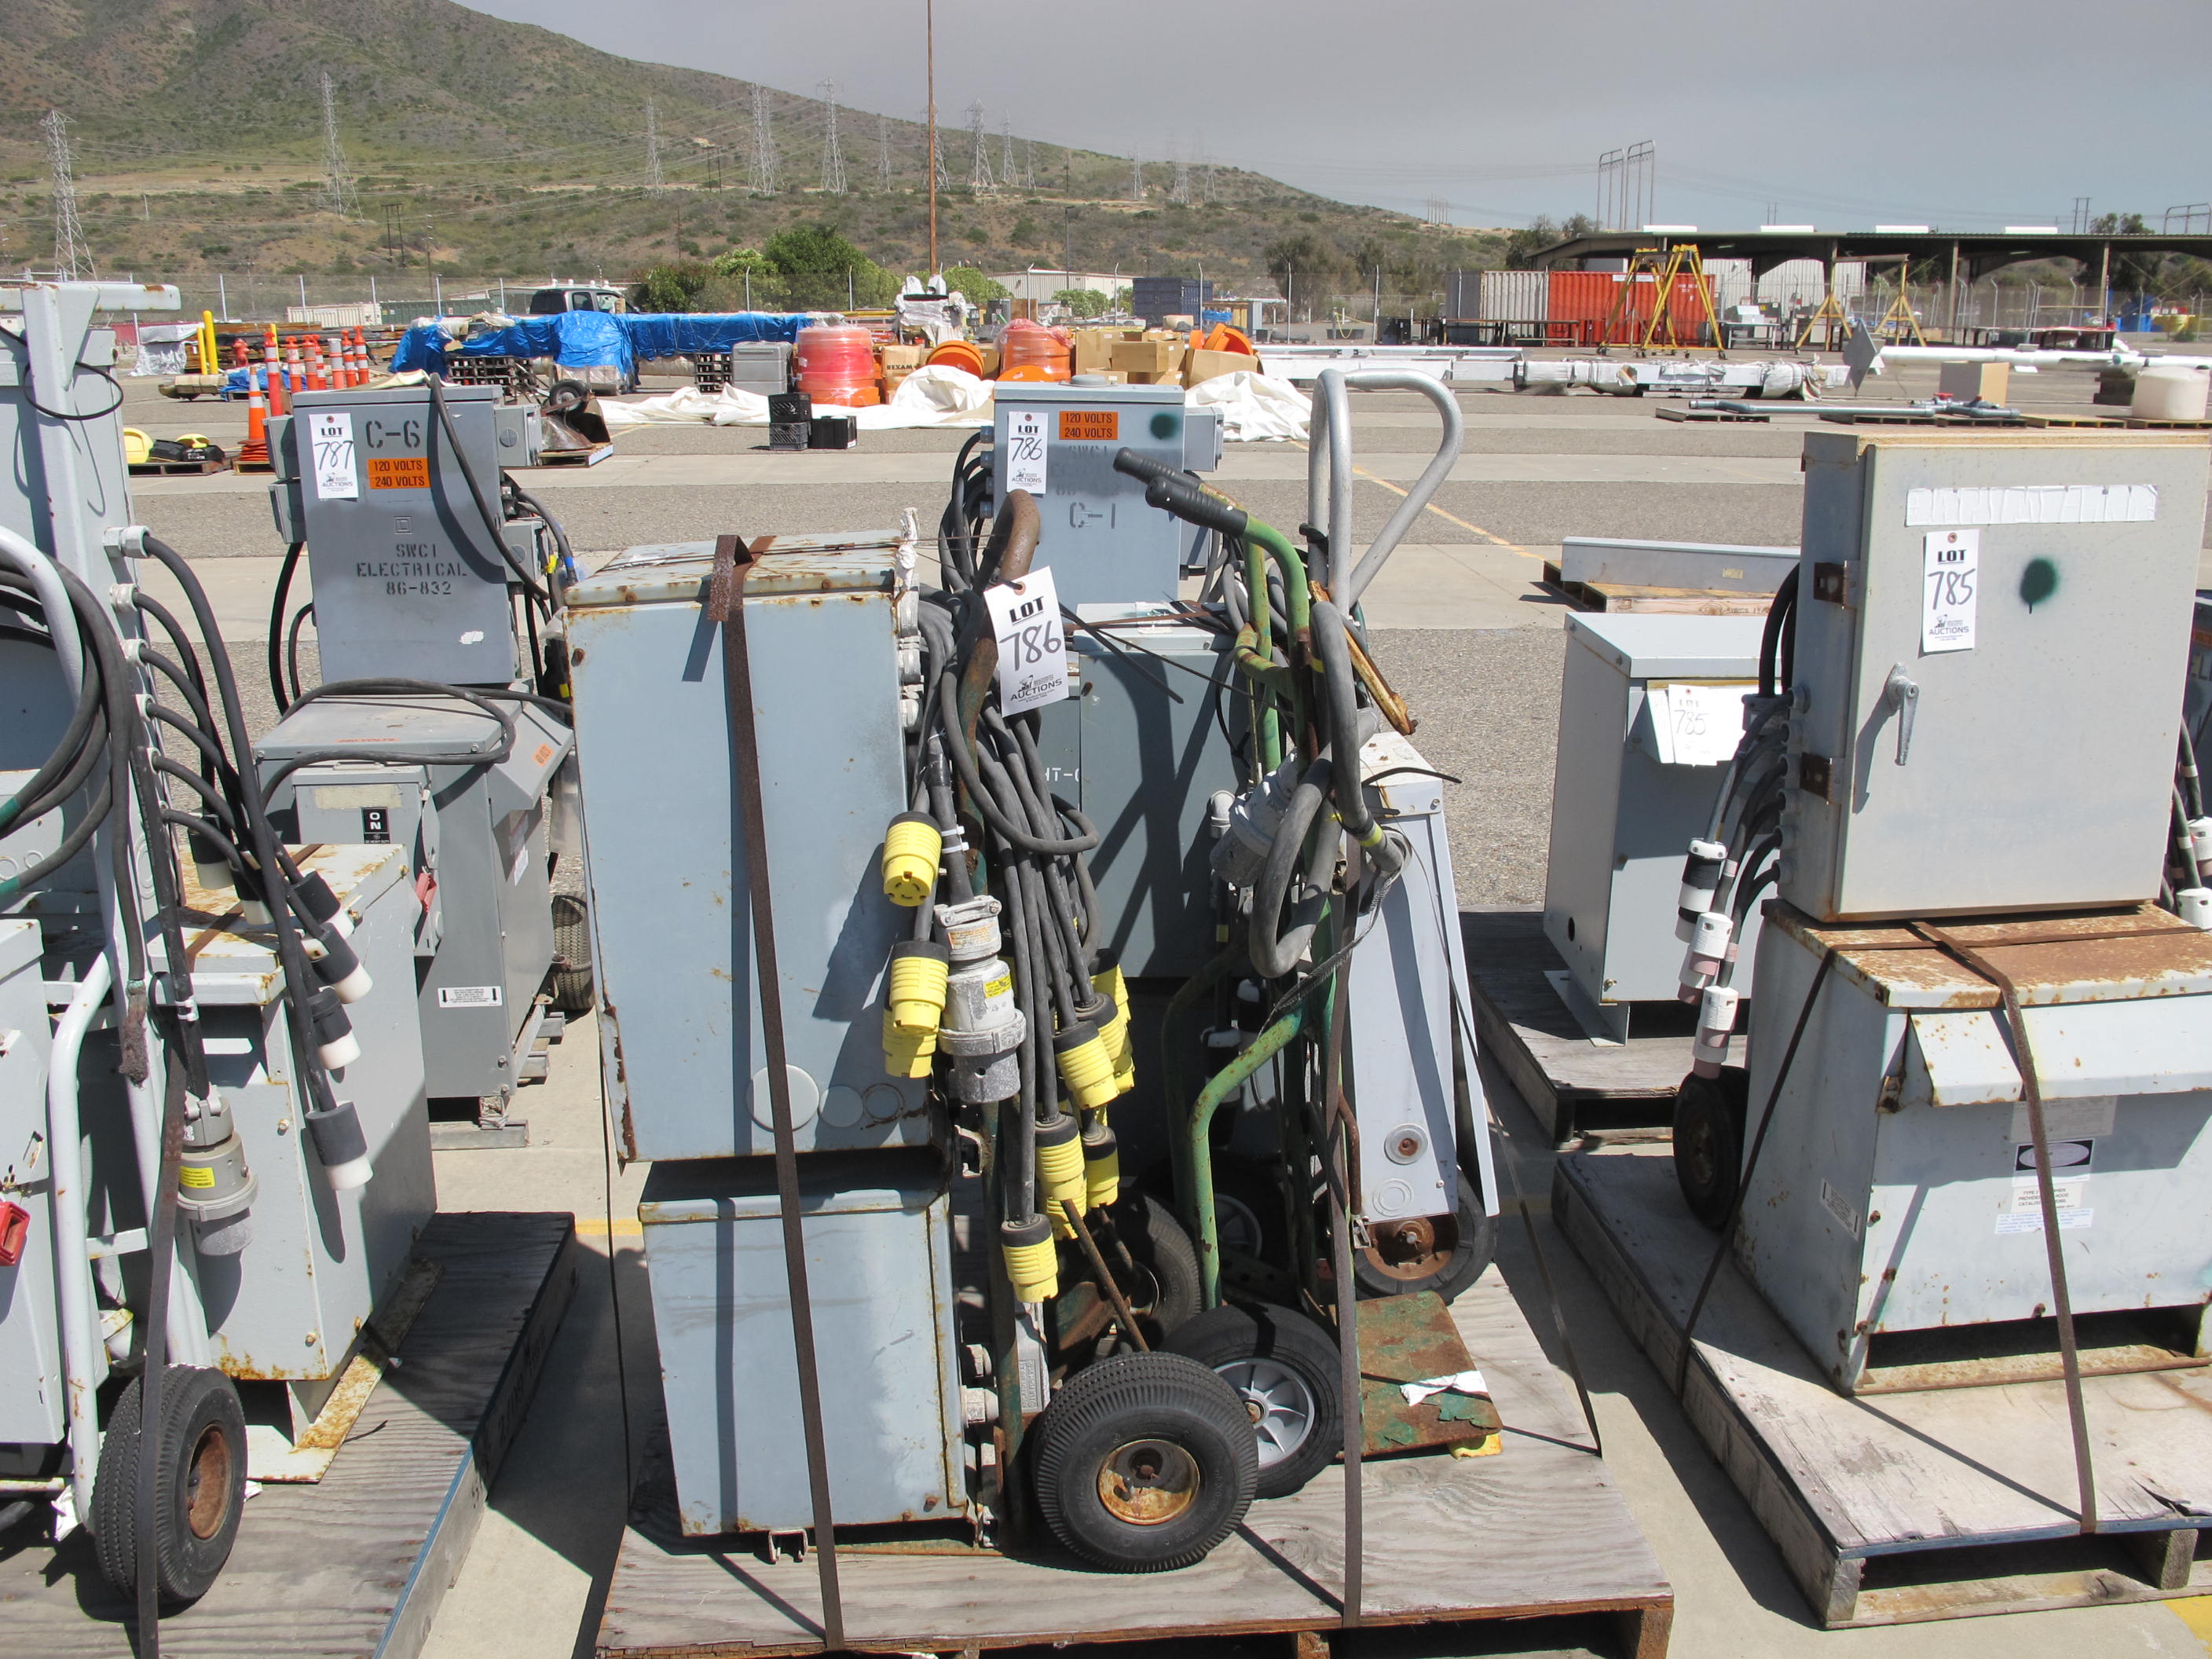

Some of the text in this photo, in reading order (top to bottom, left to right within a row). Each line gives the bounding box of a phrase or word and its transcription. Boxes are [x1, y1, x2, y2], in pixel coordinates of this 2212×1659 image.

[1065, 413, 1112, 423] 120 VOLTS
[320, 427, 343, 435] LOT
[365, 420, 420, 449] C-6
[1064, 428, 1112, 438] 240 VOLTS
[314, 440, 353, 471] 787
[1010, 437, 1042, 461] 786
[374, 460, 423, 471] 120 VOLTS
[375, 476, 425, 487] 240 VOLTS
[1937, 549, 1967, 562] LOT
[357, 562, 467, 577] ELECTRICAL
[386, 581, 452, 595] 86-832
[1927, 568, 1976, 610] 785
[1009, 595, 1044, 623] LOT
[1929, 626, 1970, 635] AUCTIONS
[998, 620, 1061, 672] 786
[1010, 678, 1063, 701] AUCTIONS
[1674, 709, 1709, 736] 785
[369, 811, 383, 830] ON
